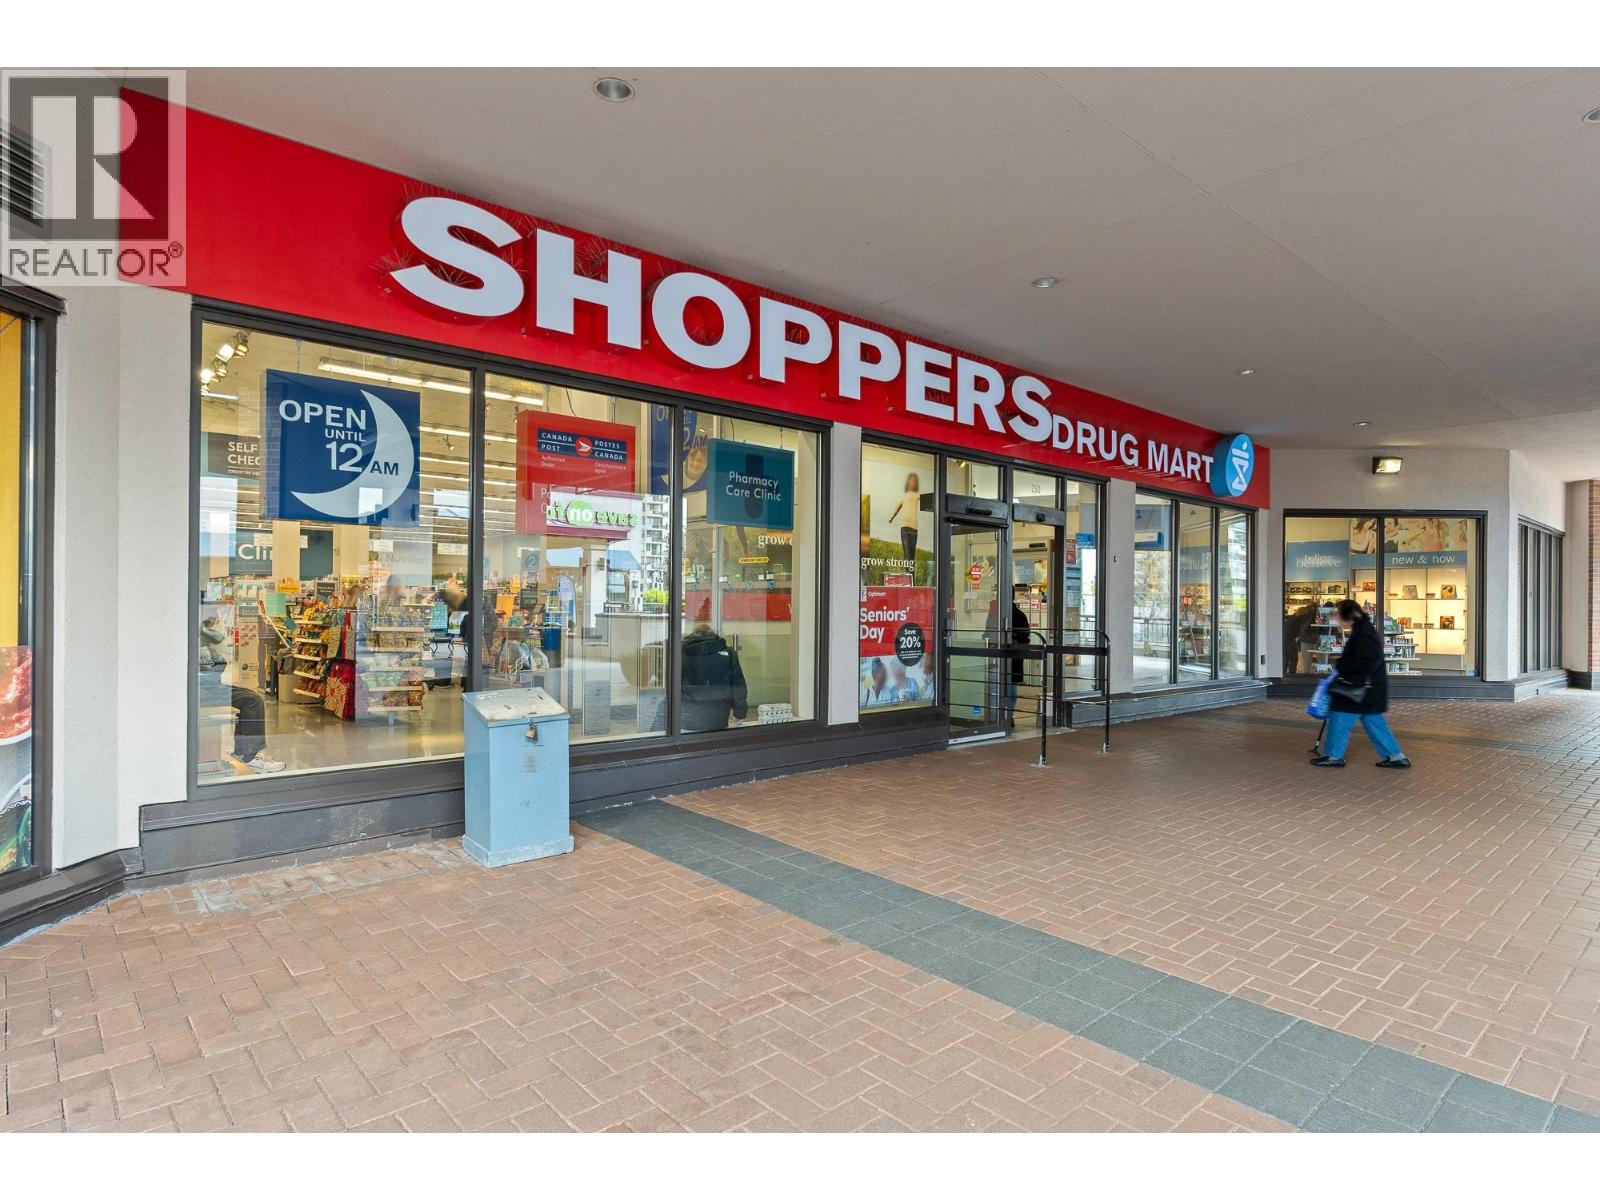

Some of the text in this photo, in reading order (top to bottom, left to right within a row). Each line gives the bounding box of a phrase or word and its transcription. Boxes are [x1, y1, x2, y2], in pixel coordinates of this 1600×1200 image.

[389, 196, 1053, 443] SHOPPERS
[279, 399, 366, 430] OPEN
[325, 429, 366, 442] UNTIL
[541, 432, 573, 443] CANADA
[228, 441, 258, 453] SELF
[541, 444, 561, 452] POST
[595, 440, 620, 450] POSTES
[1051, 414, 1214, 484] DRUG MART
[326, 441, 399, 476] 12 AM
[595, 450, 624, 461] CANADA
[729, 471, 779, 488] Pharmacy
[725, 485, 782, 502] Care Clinic
[757, 534, 787, 549] grow
[861, 556, 915, 572] grow strong
[1392, 554, 1456, 565] new & now
[860, 625, 885, 644] Day
[899, 636, 922, 649] 20%
